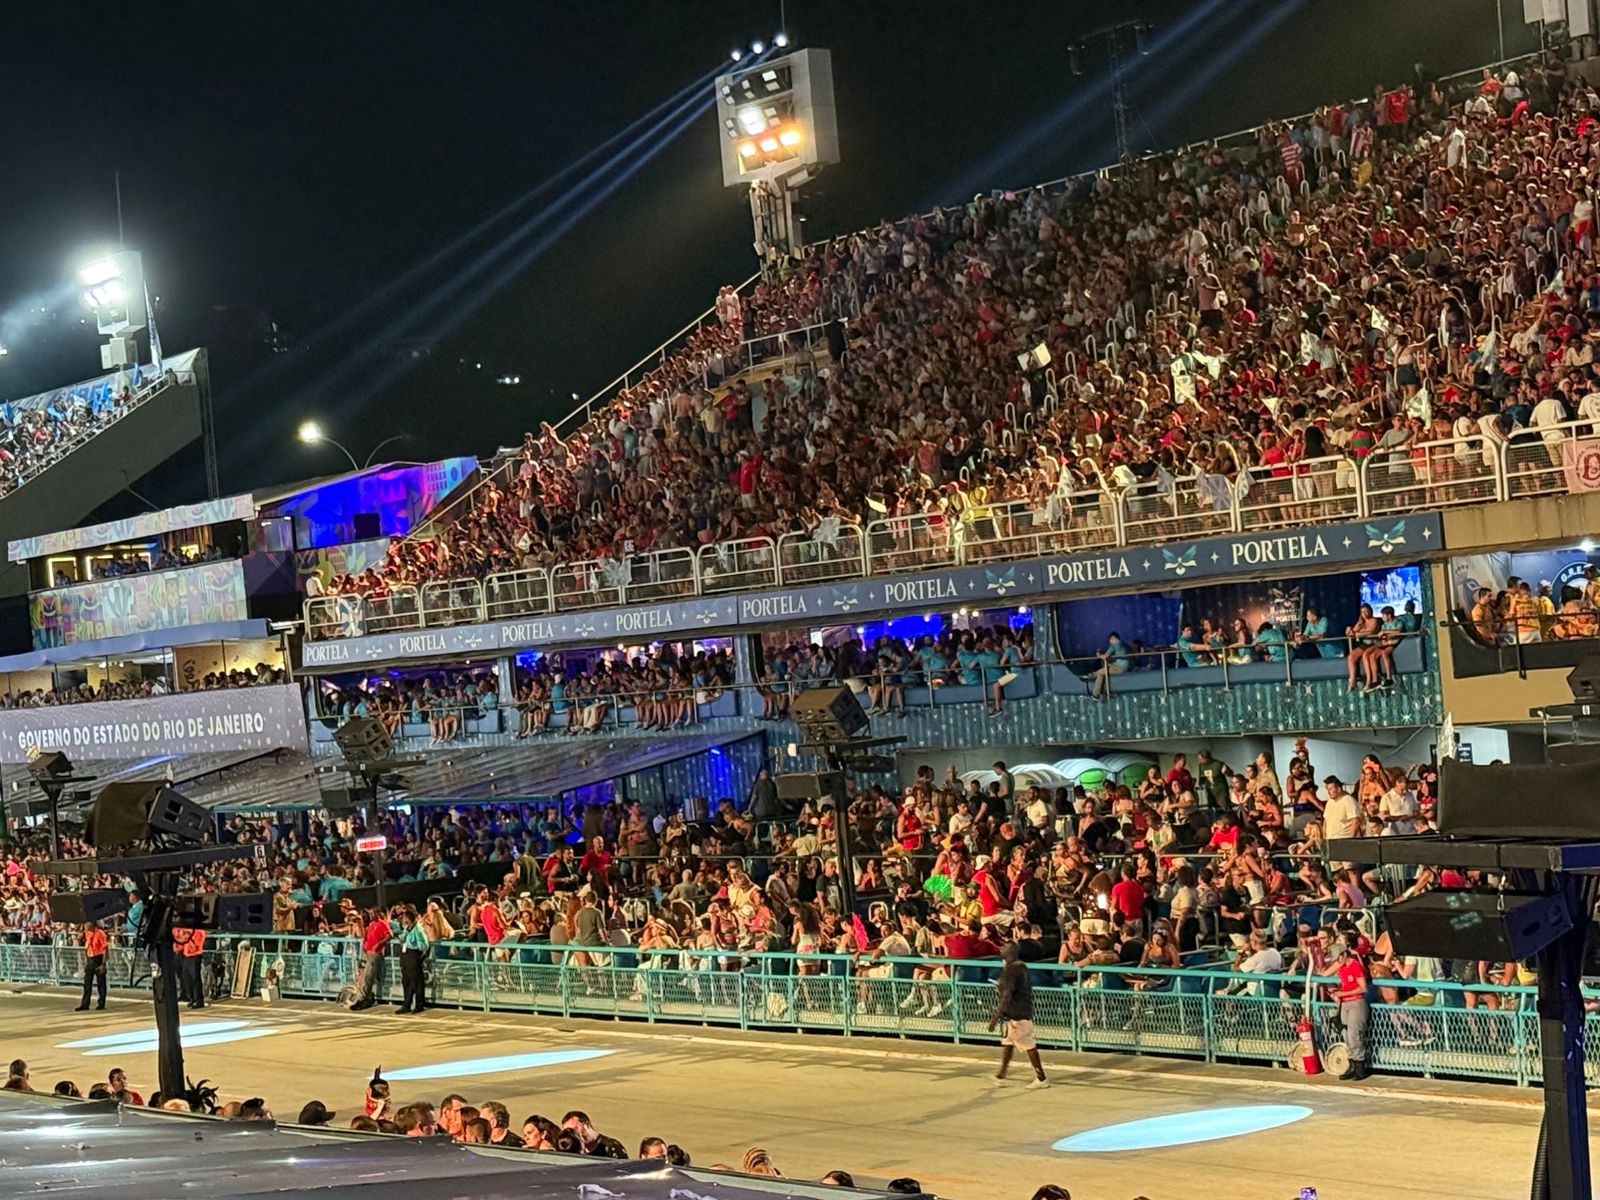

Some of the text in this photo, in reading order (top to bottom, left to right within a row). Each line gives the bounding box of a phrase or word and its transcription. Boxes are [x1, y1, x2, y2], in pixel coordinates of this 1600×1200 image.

[1231, 534, 1329, 566] PORTELA
[1048, 556, 1131, 584] PORTELA
[884, 577, 958, 603] PORTELA
[742, 594, 807, 618] PORTELA
[616, 609, 673, 631] PORTELA
[399, 634, 447, 653] PORTELA
[501, 623, 554, 642] PORTELA
[306, 645, 349, 662] PORTELA
[18, 712, 264, 749] GOVERNO DO ESTADO DO RIO DE JANEIRO
